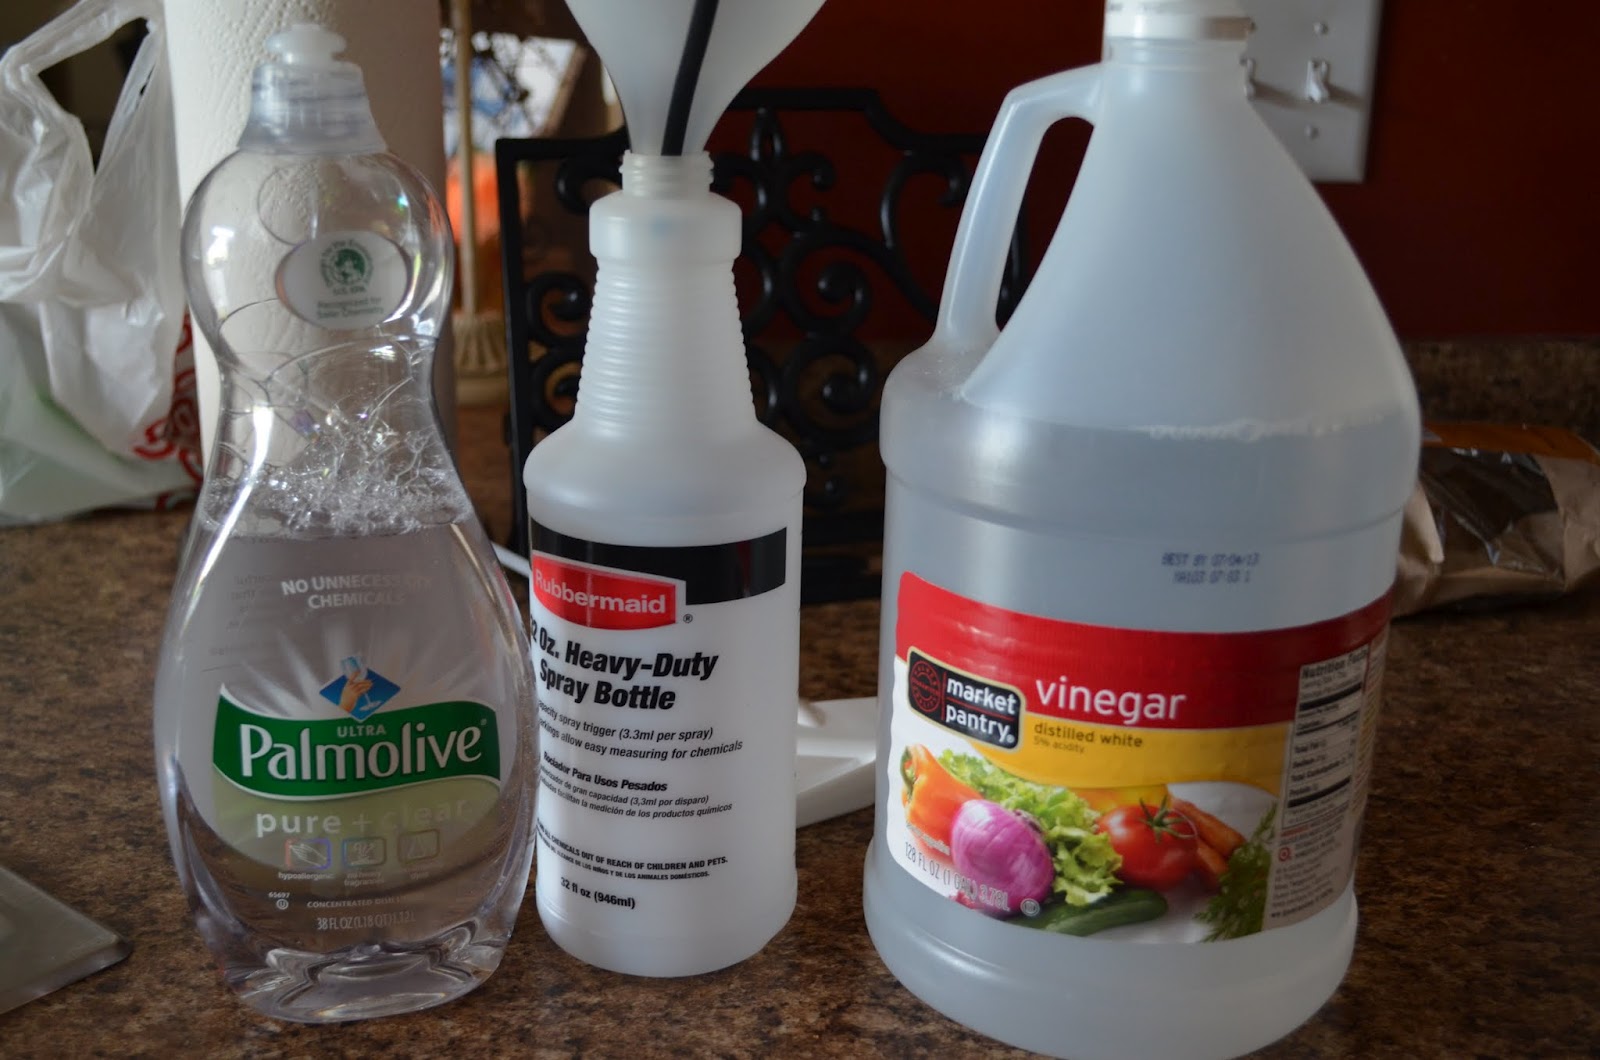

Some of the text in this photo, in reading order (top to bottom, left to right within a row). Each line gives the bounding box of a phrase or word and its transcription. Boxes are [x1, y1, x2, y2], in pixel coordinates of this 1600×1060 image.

[280, 579, 309, 596] NO
[534, 570, 666, 615] Rubbermaid
[539, 626, 560, 659] Oz.
[564, 640, 719, 682] Heavy-Duty
[540, 657, 677, 711] Spray Bottle
[946, 677, 1017, 715] market
[1035, 675, 1188, 725] vinegar
[337, 723, 387, 738] ULTRA
[559, 713, 581, 731] spray
[583, 721, 617, 738] trigger
[618, 728, 655, 740] (3.3ml
[656, 732, 676, 742] per
[678, 727, 713, 742] spray)
[945, 704, 1010, 743] pantry
[1034, 722, 1143, 748] distilled white
[239, 722, 482, 781] Palmolive
[561, 732, 583, 748] allow
[584, 741, 607, 756] easy
[609, 748, 668, 761] measuring
[671, 748, 687, 759] for
[690, 740, 743, 758] chemicals
[1052, 741, 1085, 754] acidity
[572, 767, 592, 782] Para
[594, 774, 618, 788] Usos
[620, 779, 668, 792] Pesados
[572, 784, 588, 796] gran
[588, 790, 629, 804] capacidad
[658, 799, 673, 808] por
[674, 795, 709, 806] disparo)
[256, 811, 342, 838] pure
[589, 803, 624, 816] medición
[625, 809, 636, 817] de
[638, 809, 650, 818] los
[652, 809, 695, 819] productos
[581, 850, 594, 861] OUT
[596, 855, 605, 864] OF
[606, 857, 632, 868] REACH
[634, 861, 644, 870] OF
[646, 862, 687, 870] CHILDREN
[688, 860, 705, 869] AND
[707, 856, 728, 867] PETS.
[905, 841, 917, 863] 128
[918, 852, 927, 873] FL
[278, 871, 336, 882] hypoallergenic
[306, 900, 373, 909] CONCENTRATED
[560, 876, 570, 890] 32
[580, 888, 591, 898] oz
[594, 890, 635, 910] (946ml)
